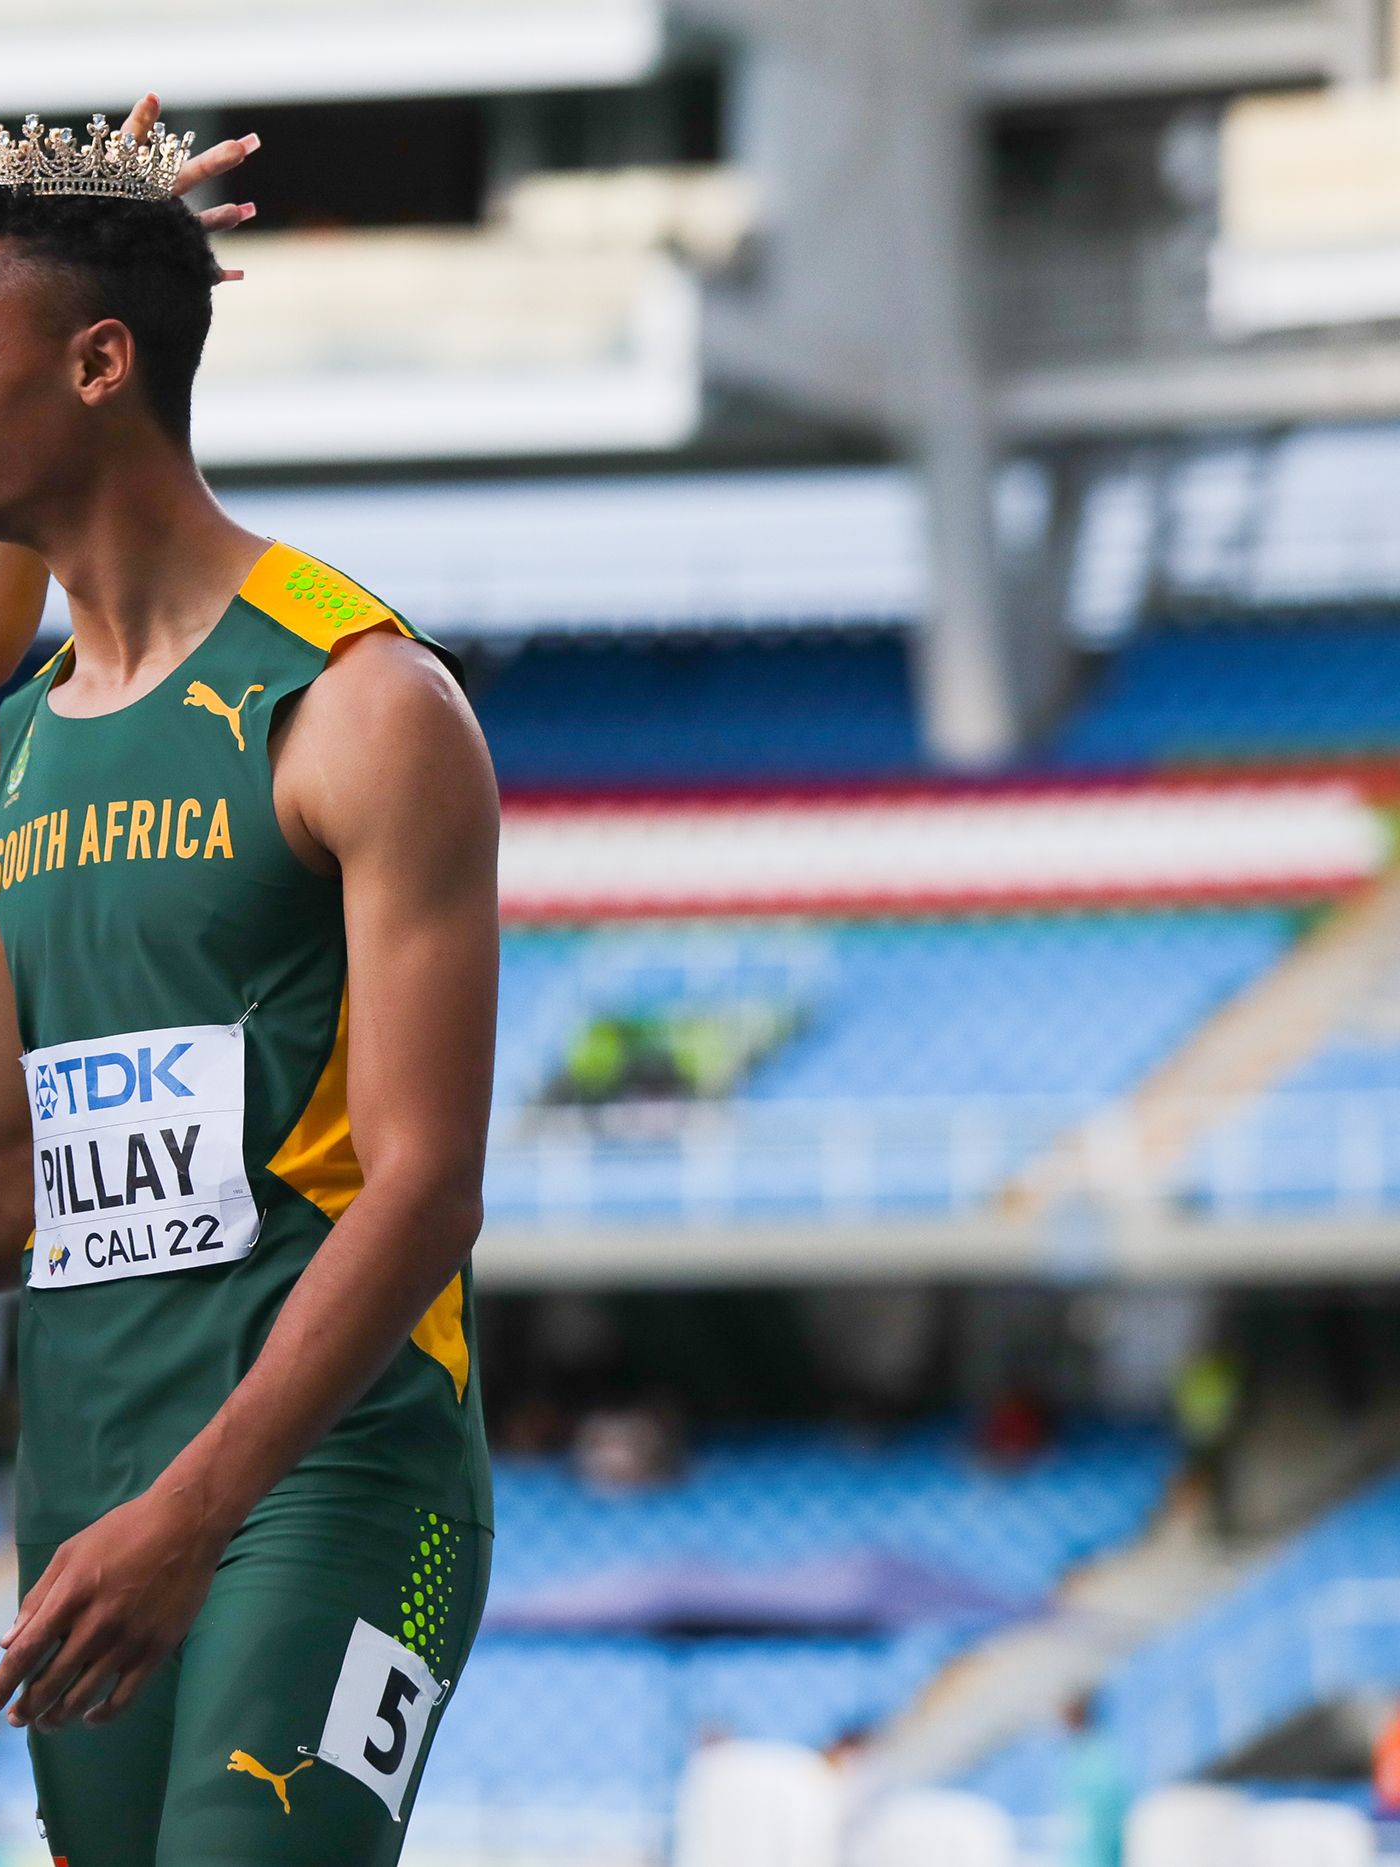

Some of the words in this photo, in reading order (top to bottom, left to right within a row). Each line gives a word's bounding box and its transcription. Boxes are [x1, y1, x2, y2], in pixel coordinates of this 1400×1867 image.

[78, 798, 235, 866] AFRICA
[55, 1042, 195, 1115] TDK
[40, 1124, 202, 1219] PILLAY
[85, 1224, 157, 1268] CALI
[164, 1214, 223, 1256] 22
[363, 1665, 421, 1776] 5
